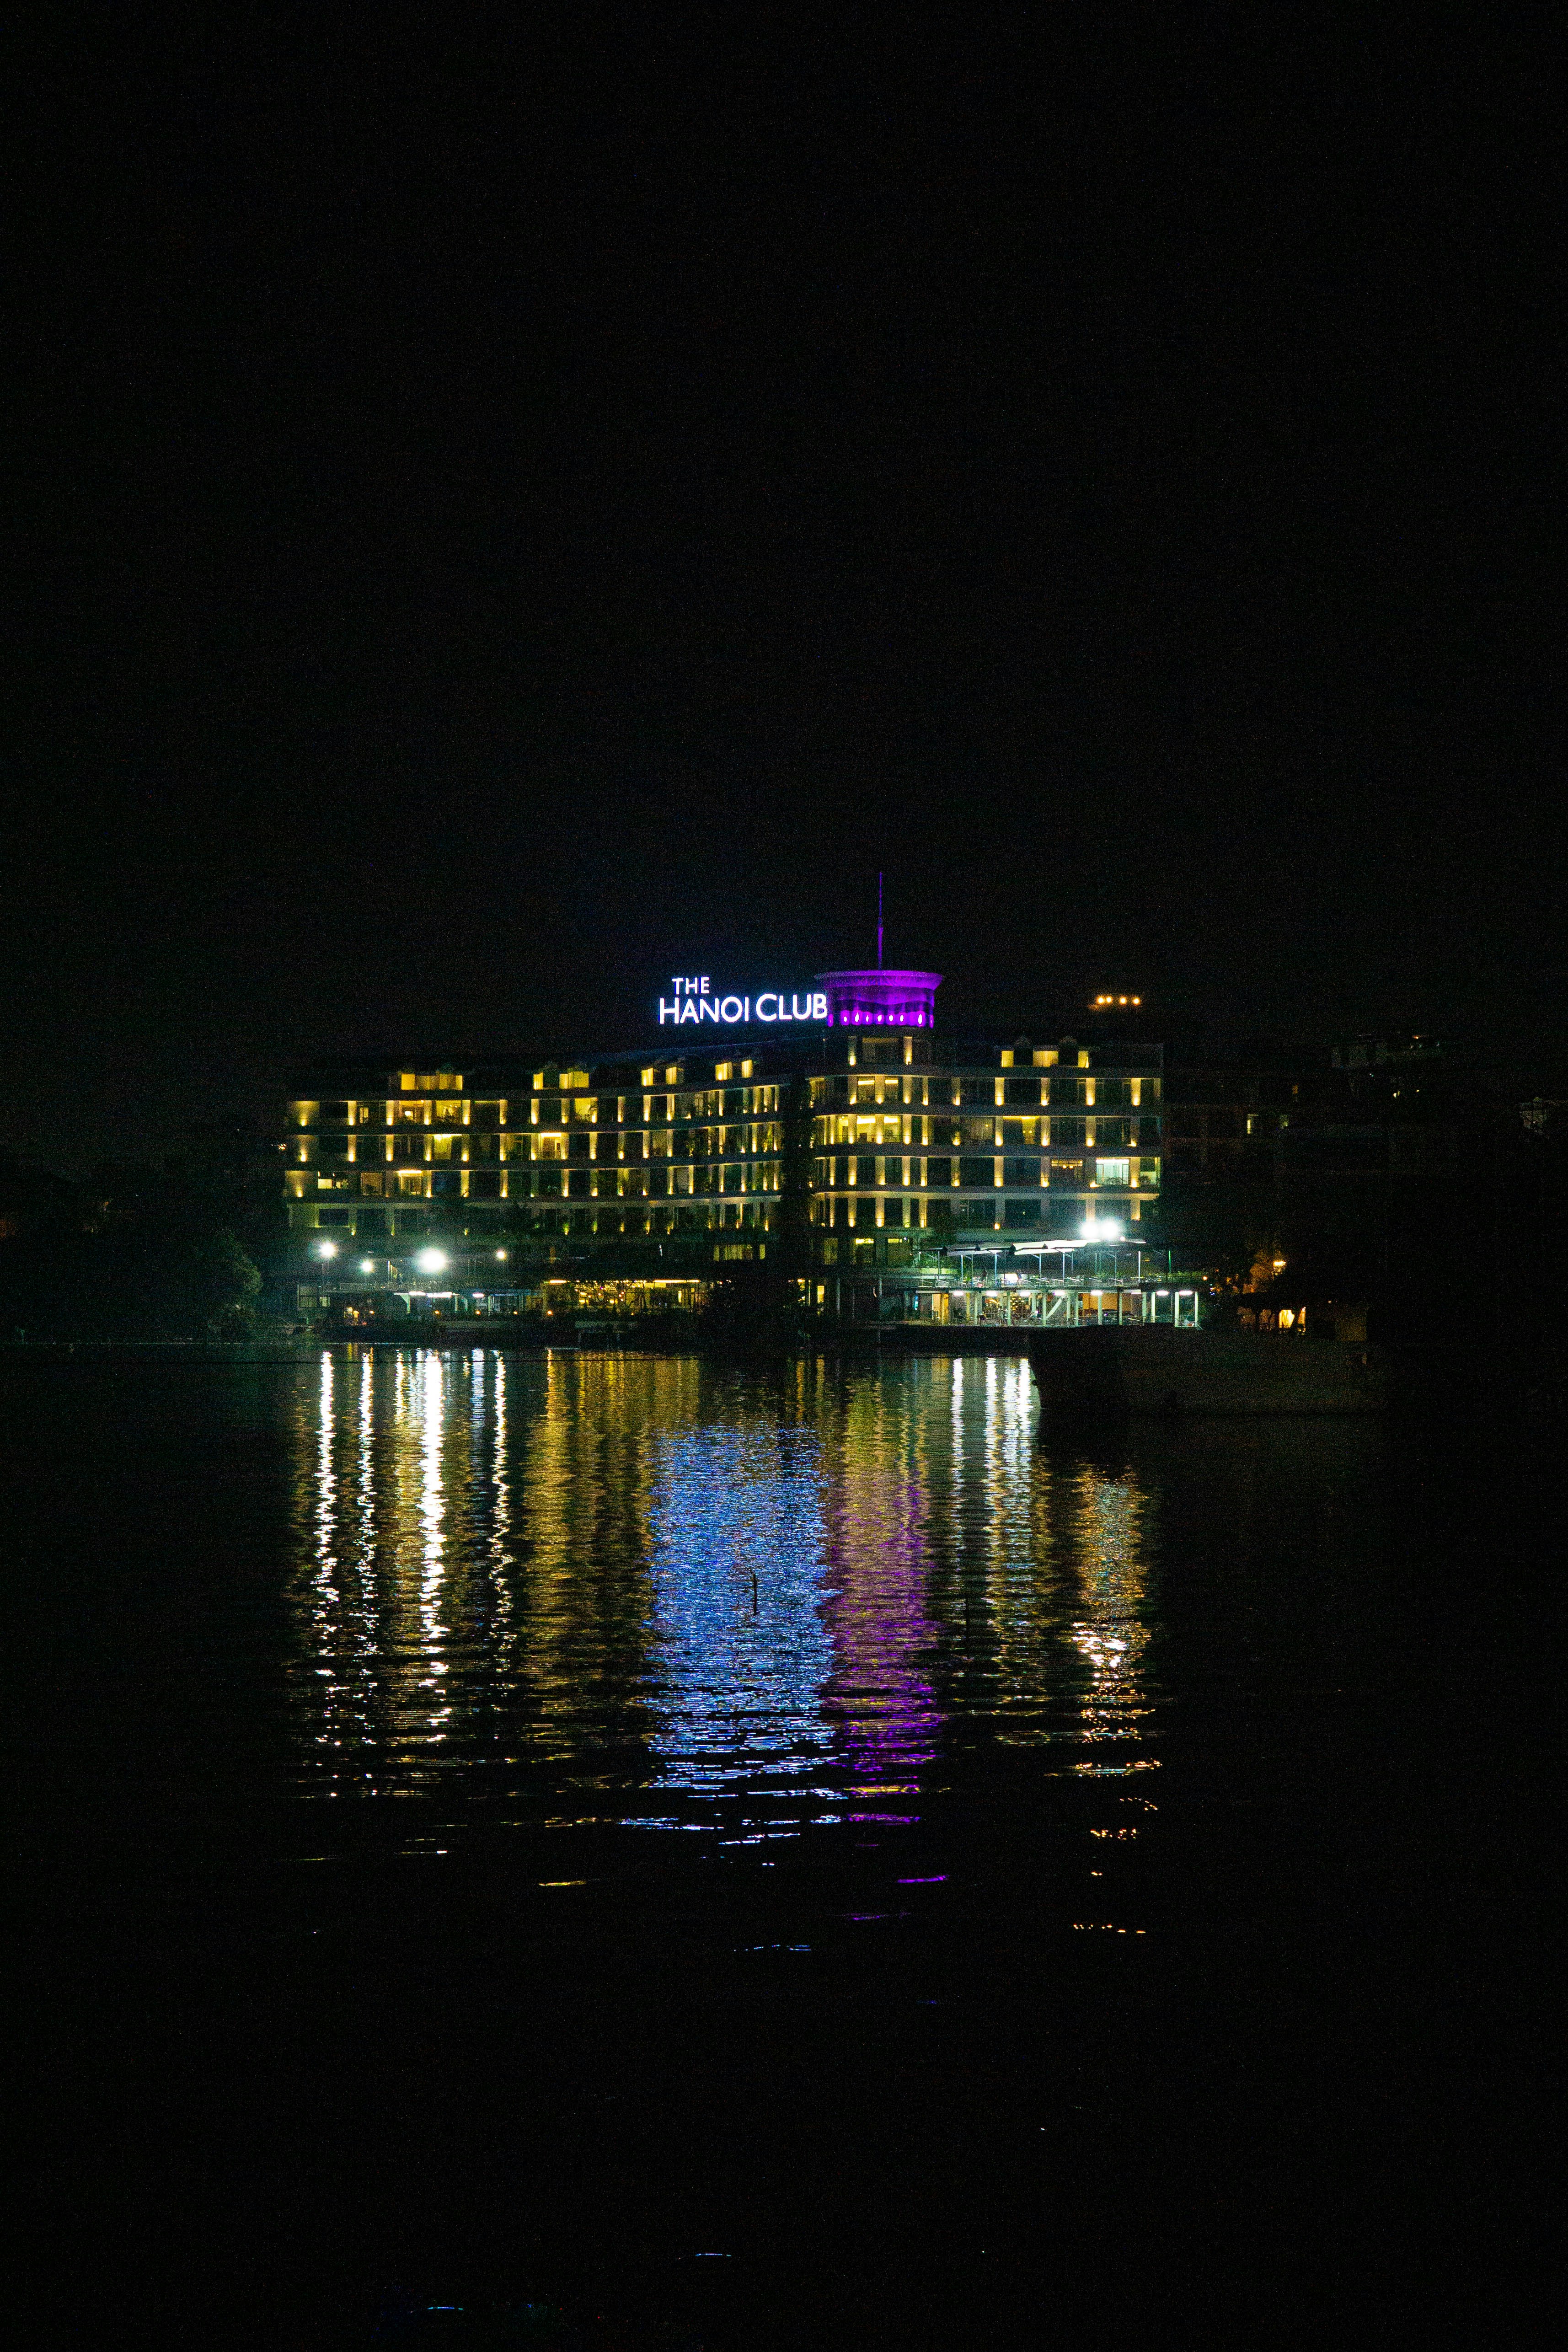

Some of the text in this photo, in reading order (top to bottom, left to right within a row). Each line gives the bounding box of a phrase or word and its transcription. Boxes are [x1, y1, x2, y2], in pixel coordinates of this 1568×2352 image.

[672, 976, 710, 995] THE
[659, 993, 828, 1024] HANOI CLUB
